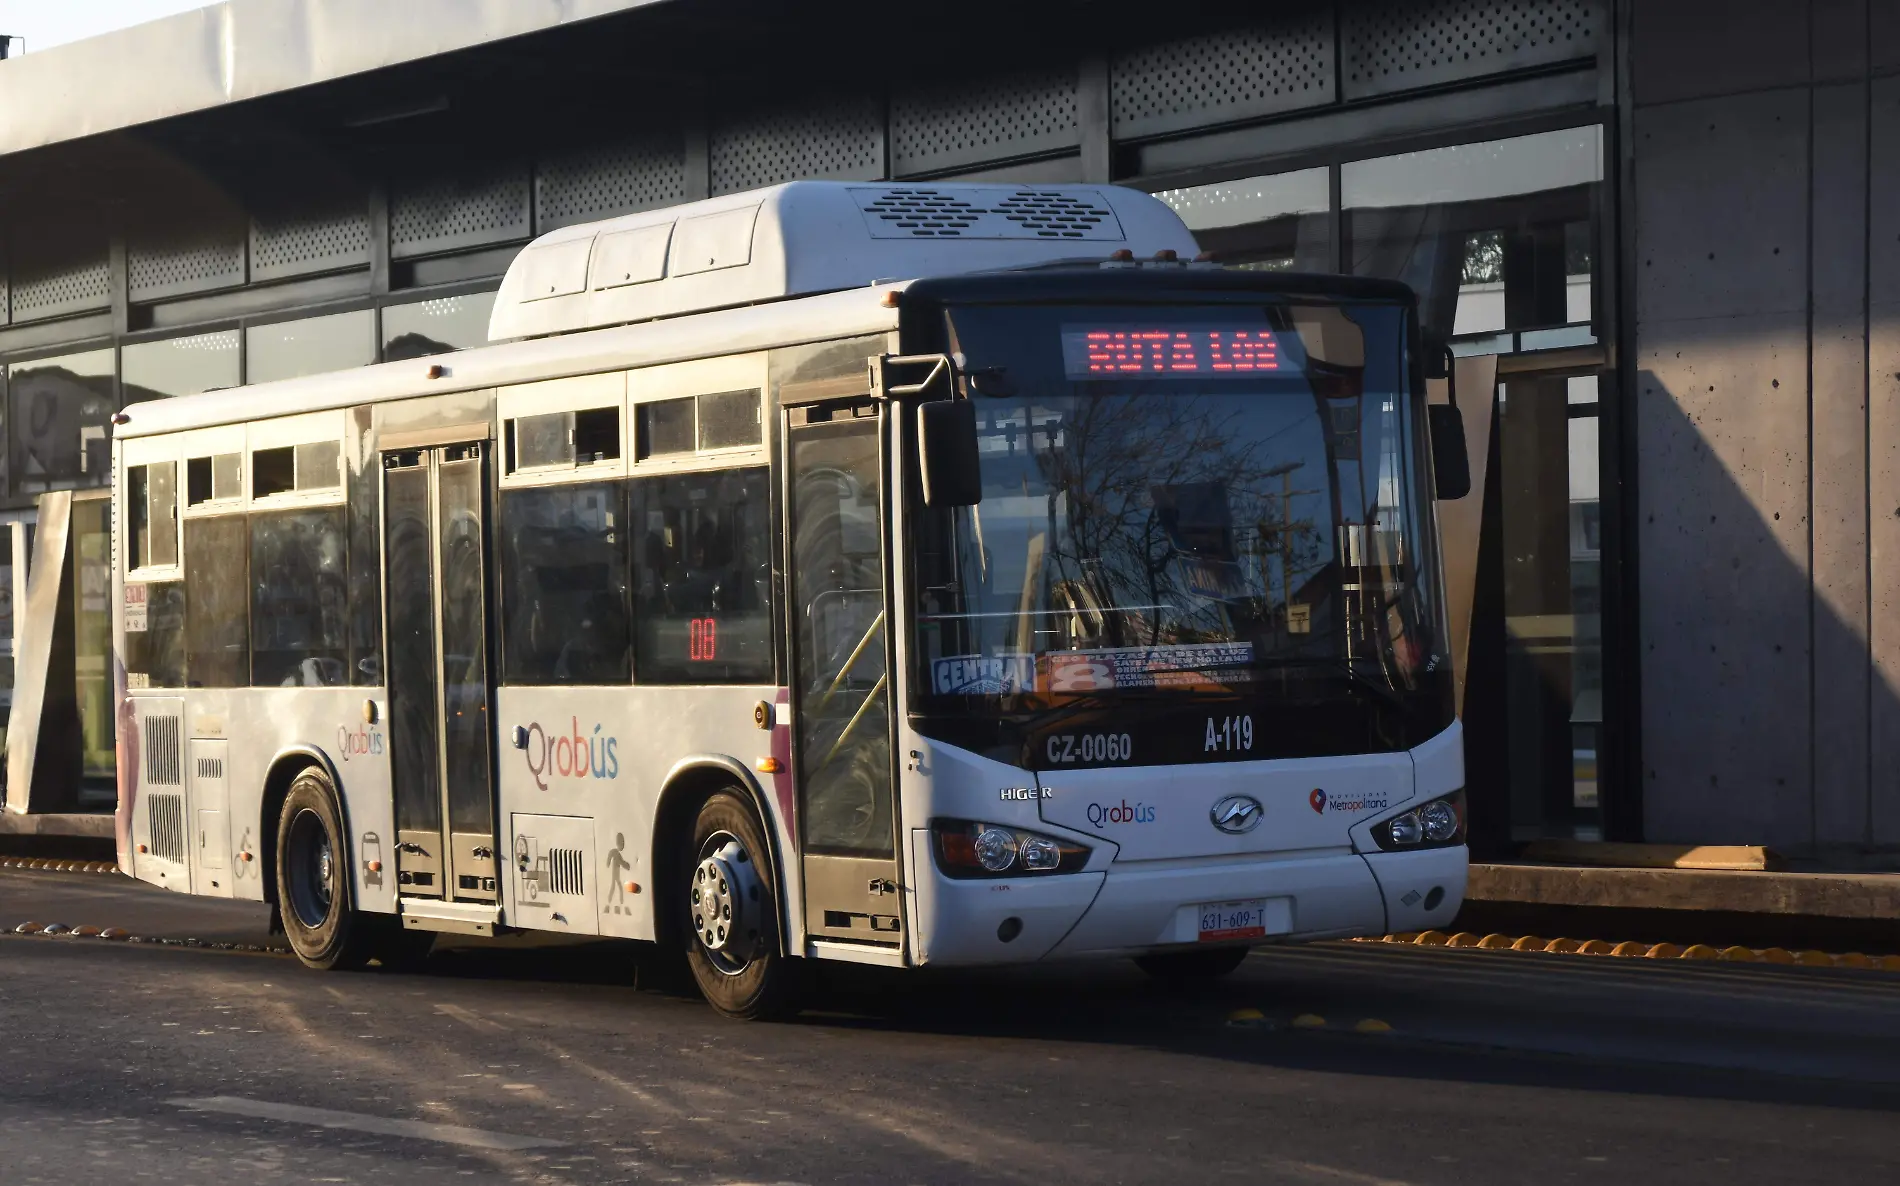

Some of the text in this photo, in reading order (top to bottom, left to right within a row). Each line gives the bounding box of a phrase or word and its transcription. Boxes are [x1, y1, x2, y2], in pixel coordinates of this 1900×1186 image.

[690, 618, 716, 660] 08
[1085, 652, 1146, 662] PLAZAS
[937, 658, 1033, 694] CENTRAL
[1051, 663, 1115, 691] 8
[337, 725, 383, 762] Qrobús
[1204, 715, 1253, 751] A-119
[526, 716, 619, 791] Qrobús
[1047, 733, 1132, 763] CZ-0060
[1000, 787, 1052, 800] HIGER
[1329, 798, 1387, 813] Metropolitana
[1087, 800, 1155, 829] Qrobús
[1202, 908, 1264, 930] 631-609-T
